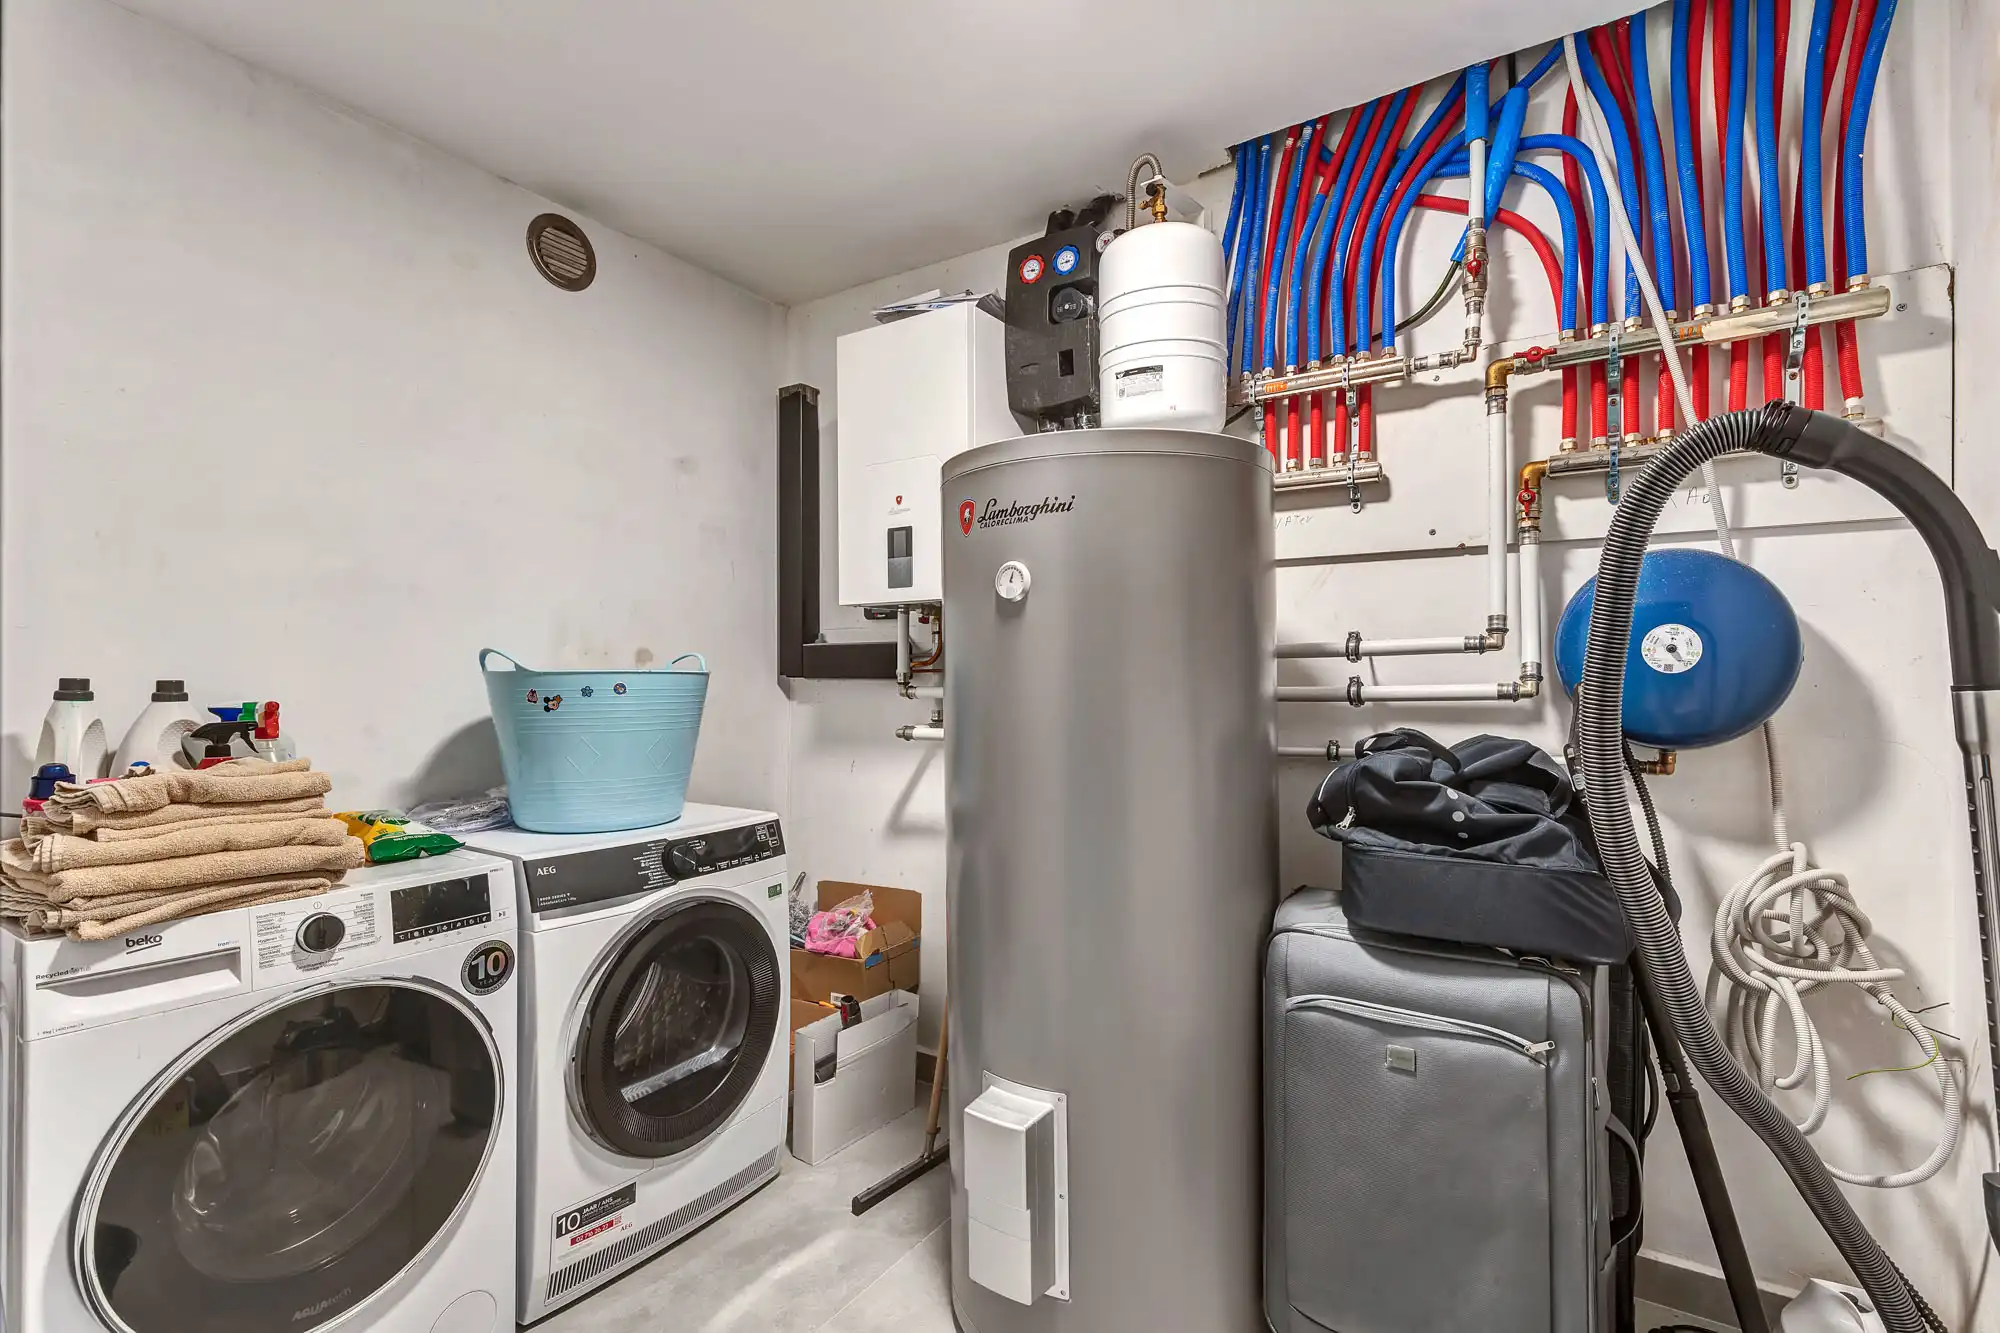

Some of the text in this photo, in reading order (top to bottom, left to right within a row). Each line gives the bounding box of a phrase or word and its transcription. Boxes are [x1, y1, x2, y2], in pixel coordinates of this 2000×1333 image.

[977, 495, 1076, 523] Lamborghini
[980, 517, 1029, 529] CALORECLIMA
[536, 865, 557, 877] AEG
[125, 934, 162, 949] beko
[471, 951, 506, 980] 10
[479, 977, 498, 986] YEAR
[582, 1203, 598, 1215] JAAR
[601, 1197, 613, 1206] ANS
[558, 1212, 581, 1235] 10
